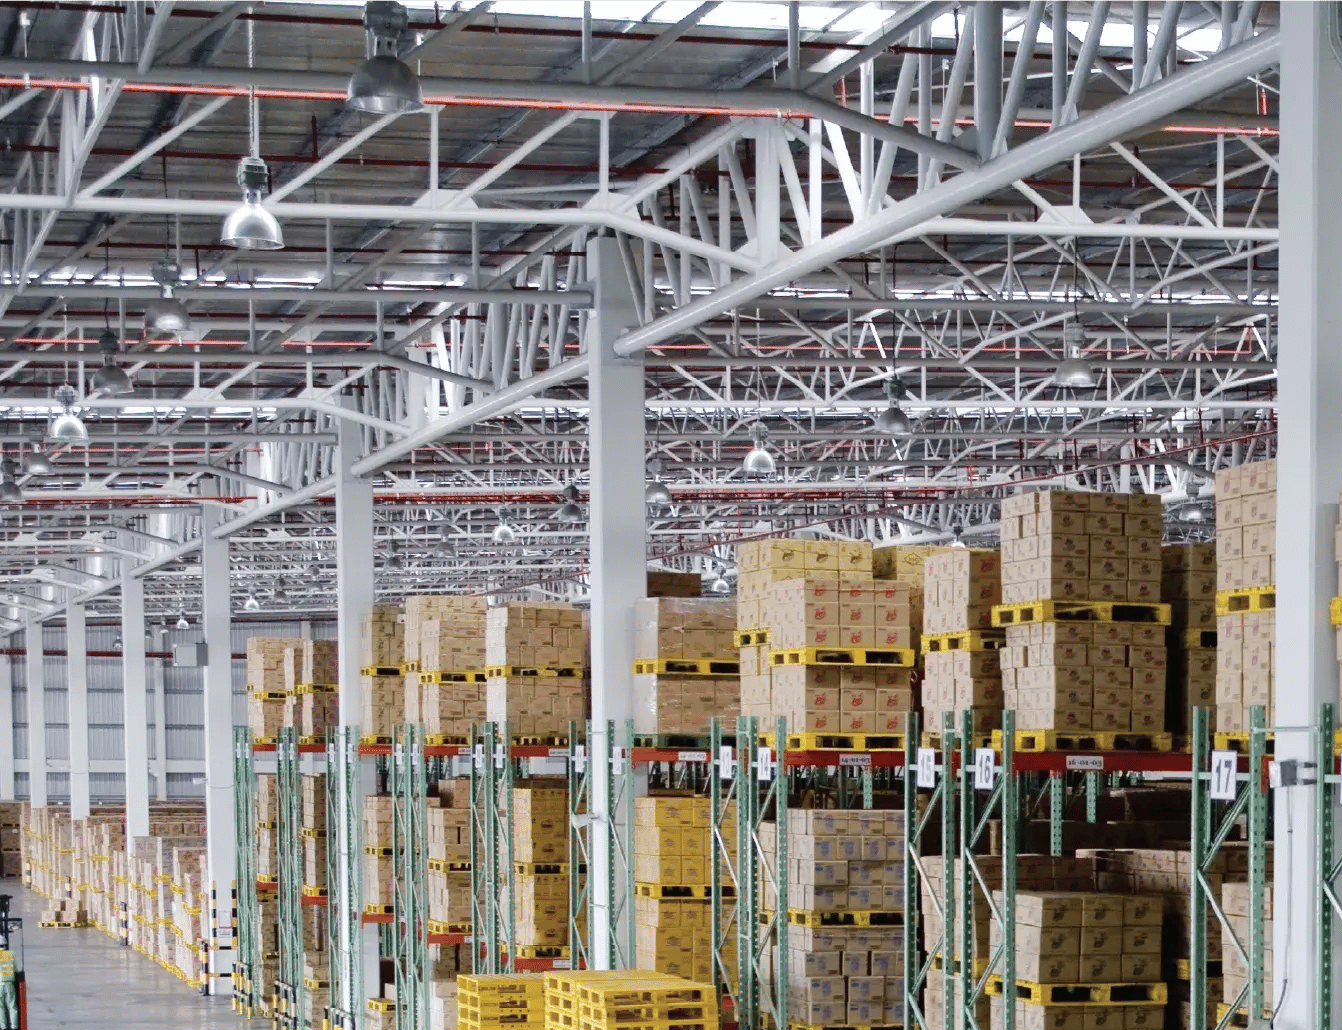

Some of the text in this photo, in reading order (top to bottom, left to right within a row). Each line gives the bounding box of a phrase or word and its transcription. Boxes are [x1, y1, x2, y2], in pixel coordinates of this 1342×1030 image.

[921, 753, 932, 782] 15
[979, 753, 991, 784] 16
[1215, 760, 1233, 793] 17
